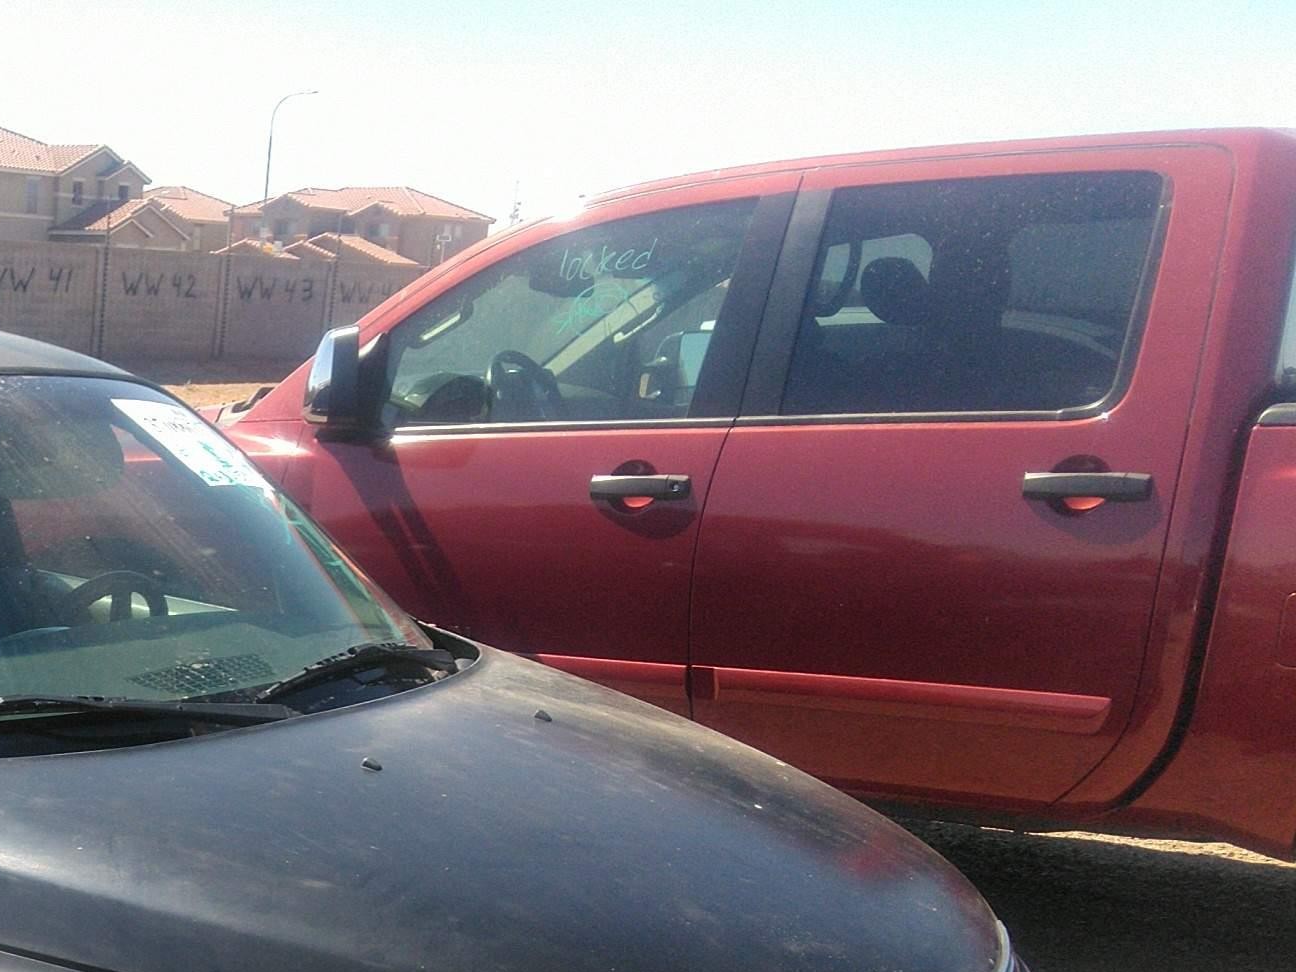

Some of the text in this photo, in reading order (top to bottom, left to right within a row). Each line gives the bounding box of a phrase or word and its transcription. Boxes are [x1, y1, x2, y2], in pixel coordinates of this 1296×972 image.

[559, 238, 658, 281] locked
[49, 267, 74, 293] 41
[122, 272, 197, 298] WW 42
[237, 275, 314, 300] WW 43
[340, 282, 370, 303] WW
